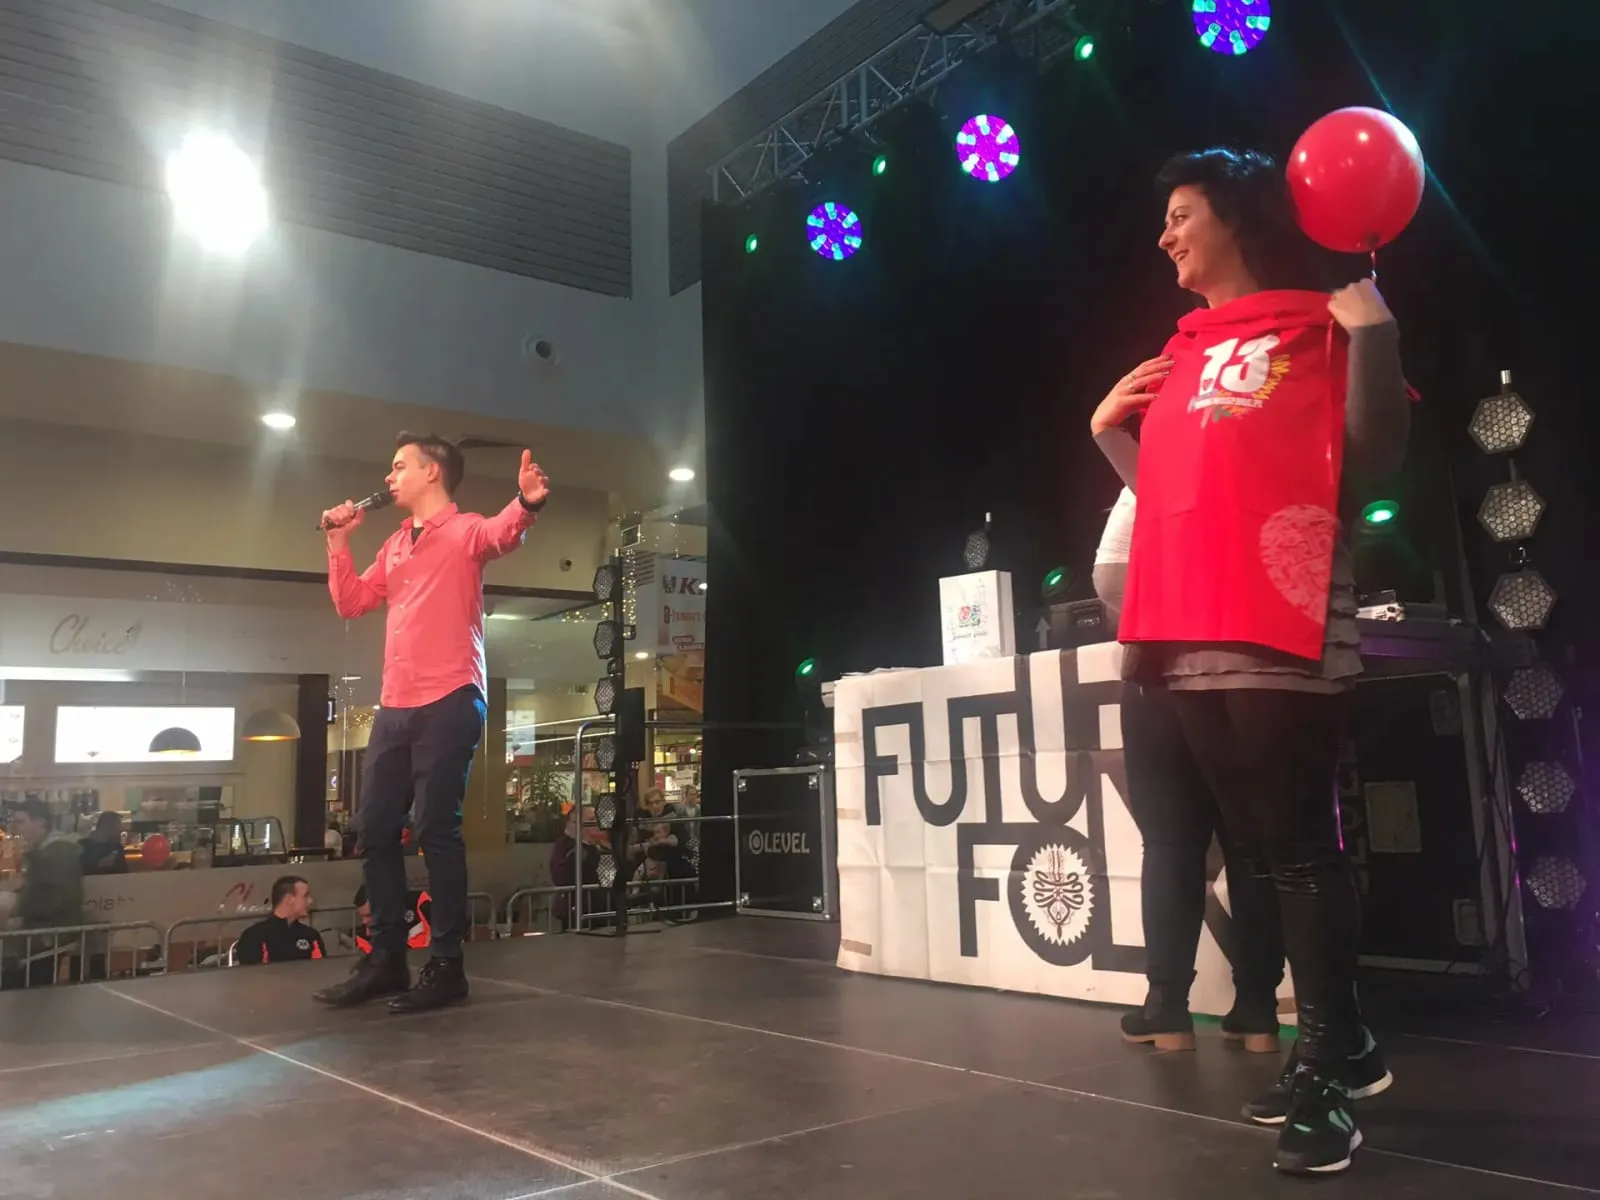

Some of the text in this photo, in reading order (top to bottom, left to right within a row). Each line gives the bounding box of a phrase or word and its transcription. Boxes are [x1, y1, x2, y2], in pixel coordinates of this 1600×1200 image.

[1198, 334, 1280, 396] 13
[49, 613, 126, 655] Choice
[764, 832, 810, 854] LEVEL
